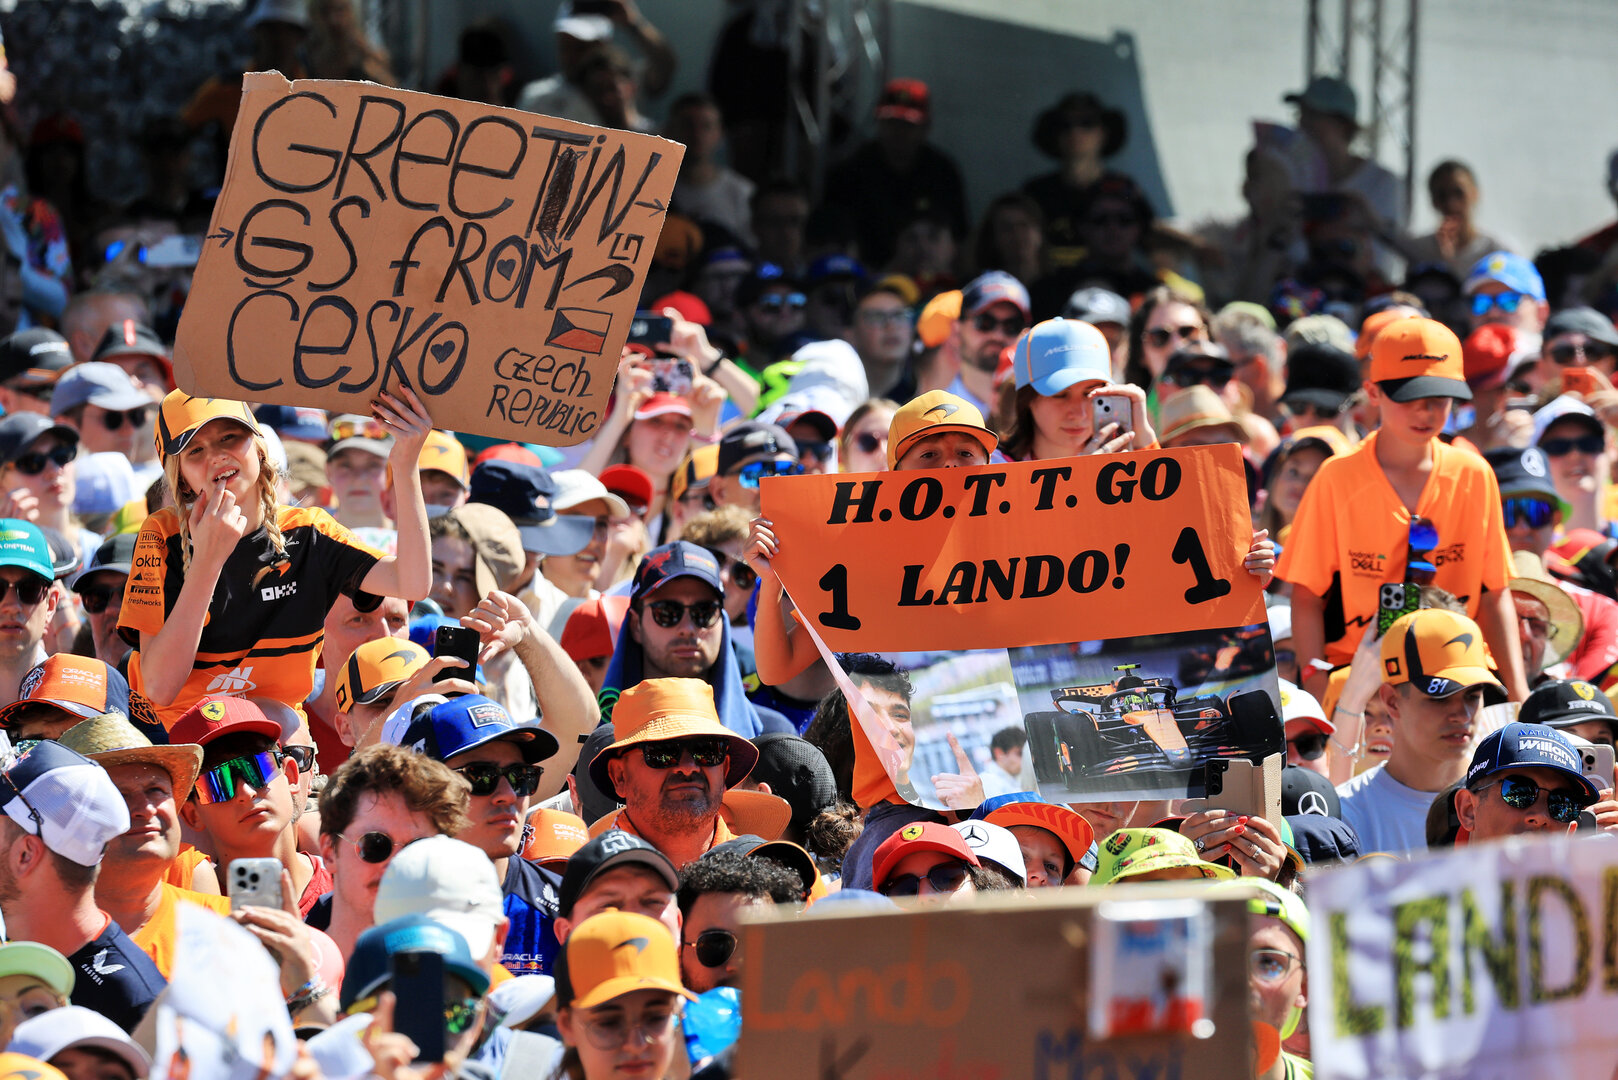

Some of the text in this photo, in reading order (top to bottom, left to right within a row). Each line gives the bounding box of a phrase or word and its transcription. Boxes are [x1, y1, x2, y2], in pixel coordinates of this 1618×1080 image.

[1096, 457, 1182, 505] GO
[142, 532, 165, 545] Hilton
[135, 554, 161, 567] okta
[898, 543, 1130, 607] LANDO!
[1171, 526, 1231, 605] 1
[127, 597, 162, 607] freshworks
[818, 563, 861, 631] 1
[62, 667, 103, 680] ORACLE
[1427, 678, 1449, 694] 81
[1519, 740, 1577, 770] Williams
[1550, 753, 1568, 766] TEAM
[1329, 865, 1618, 1037] LAND
[745, 917, 972, 1032] Lando
